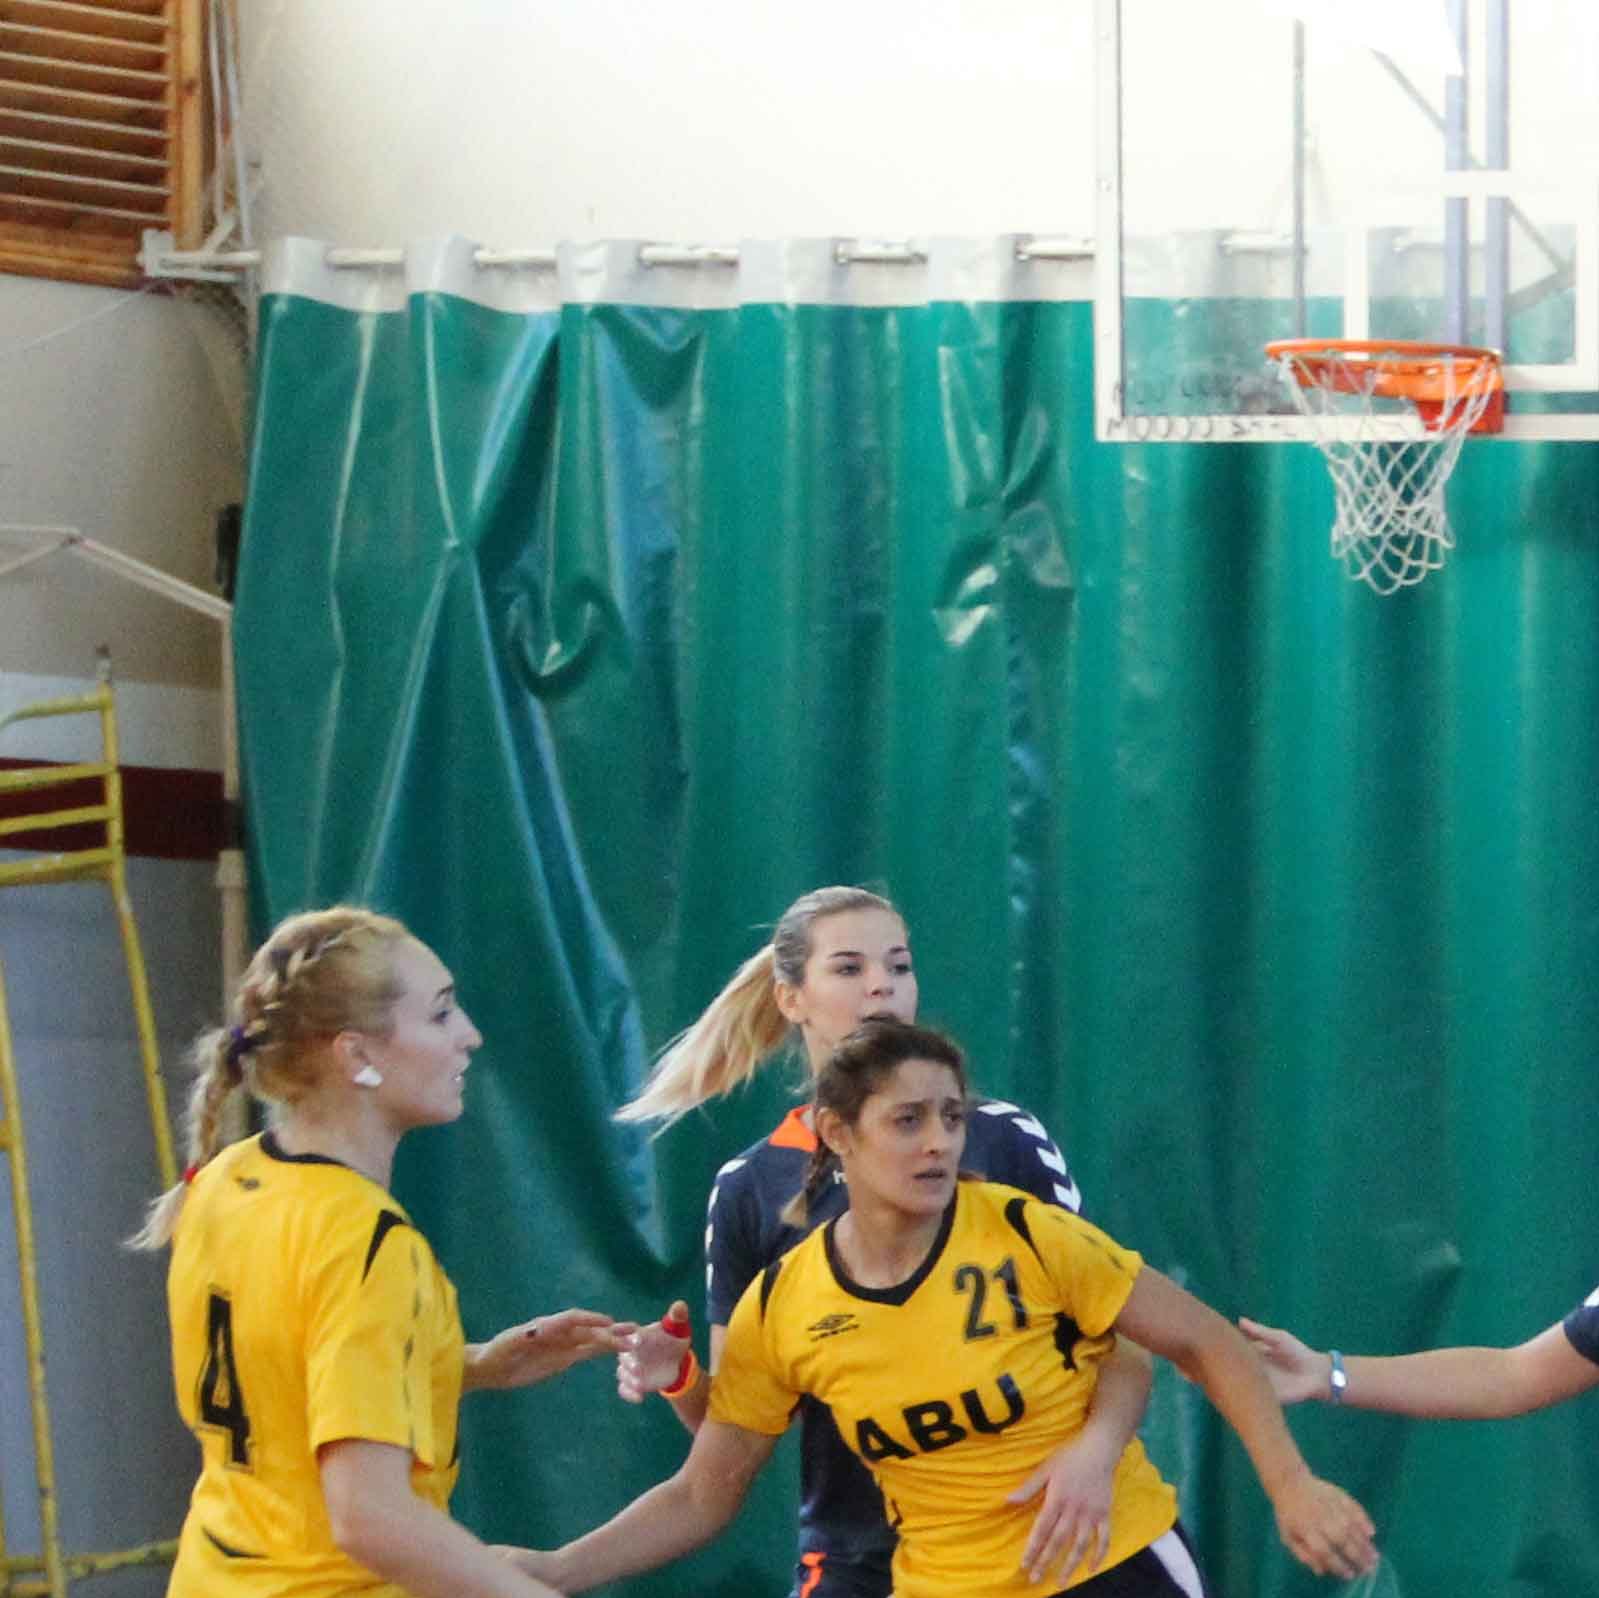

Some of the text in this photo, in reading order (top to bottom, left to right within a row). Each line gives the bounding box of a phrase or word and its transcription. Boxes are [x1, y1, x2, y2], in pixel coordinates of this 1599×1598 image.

[953, 1256, 1028, 1343] 21
[196, 1283, 256, 1473] 4
[855, 1371, 1026, 1463] ABU
